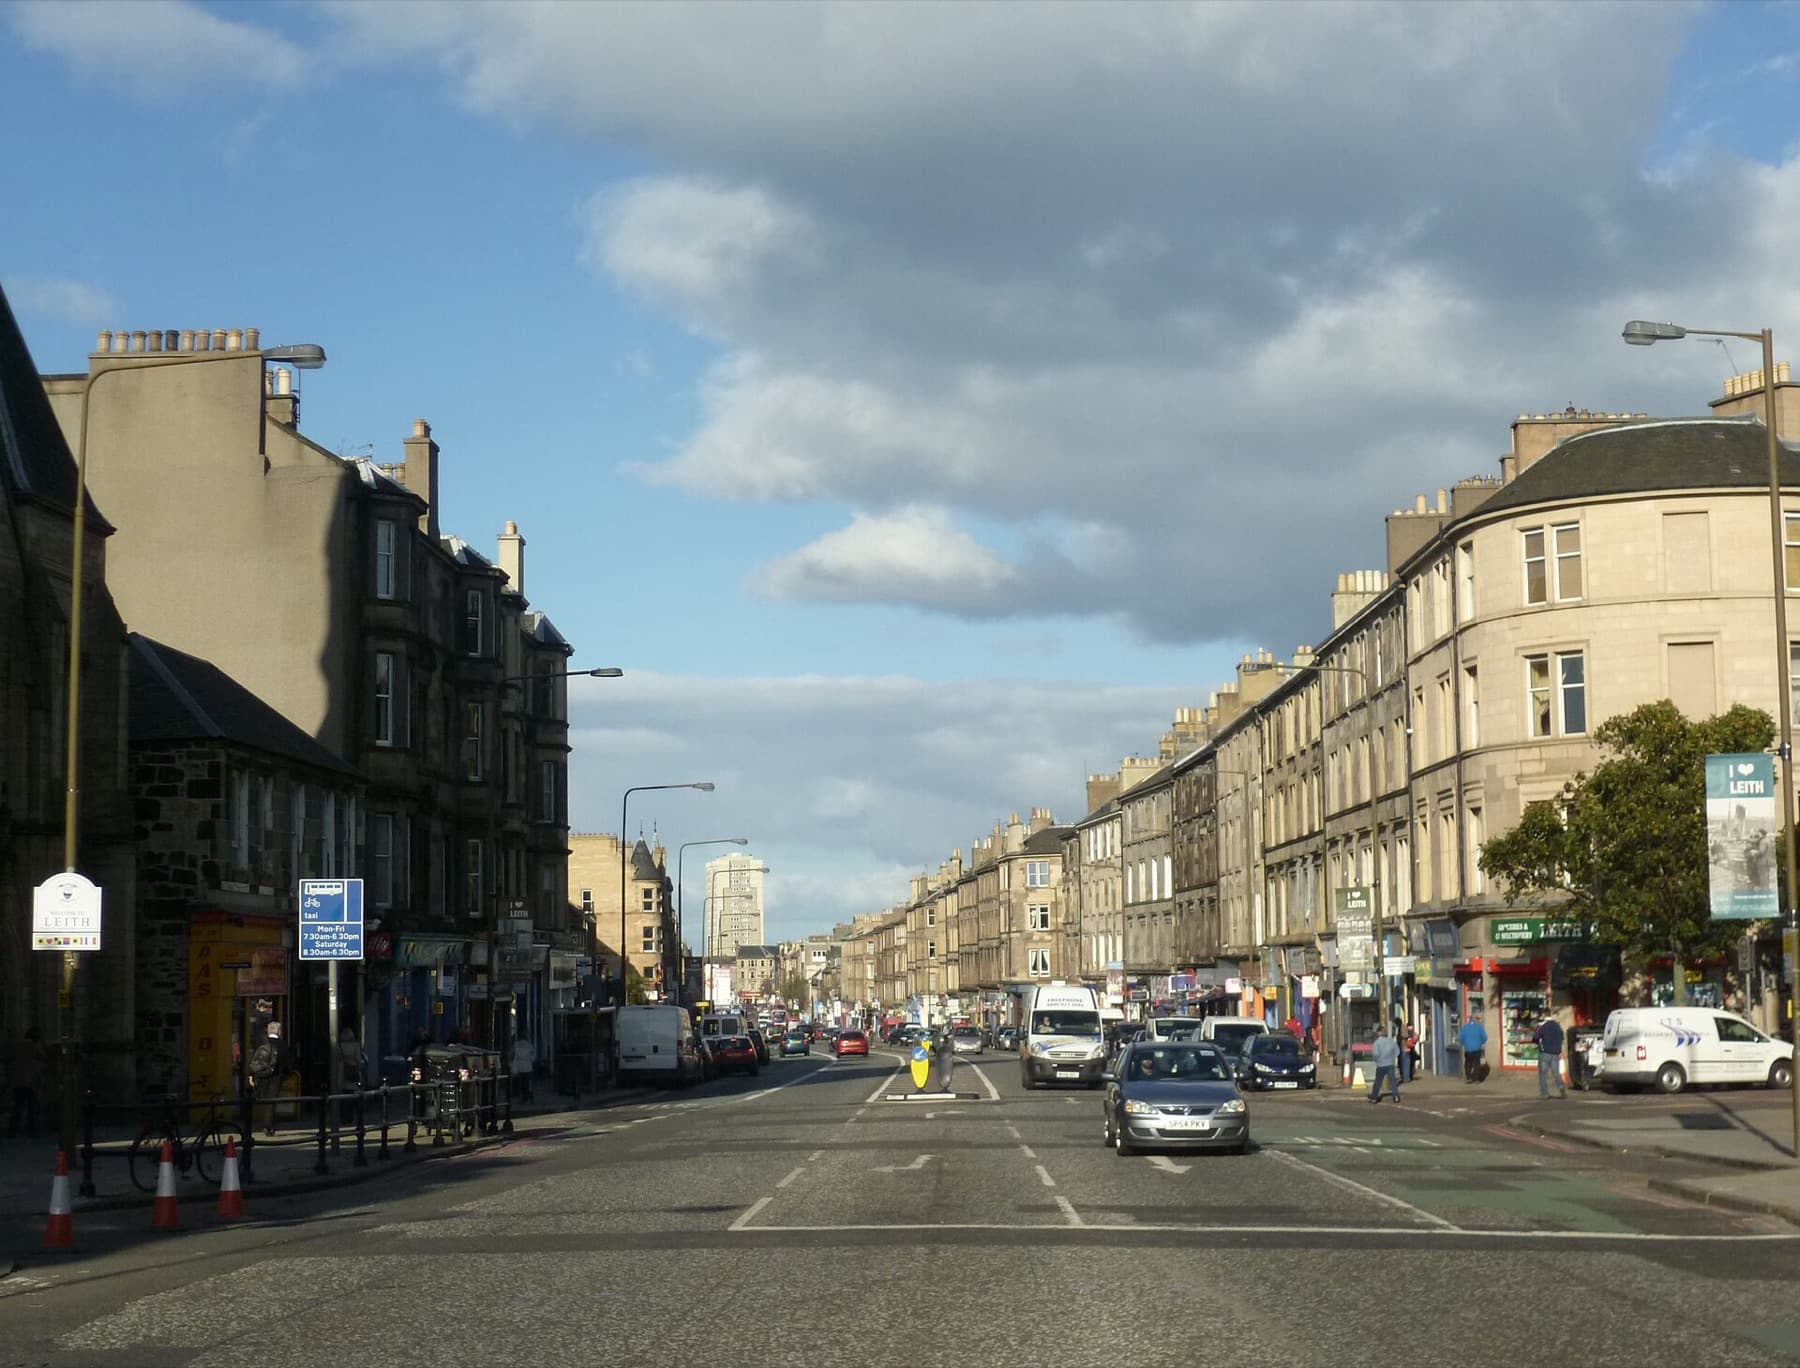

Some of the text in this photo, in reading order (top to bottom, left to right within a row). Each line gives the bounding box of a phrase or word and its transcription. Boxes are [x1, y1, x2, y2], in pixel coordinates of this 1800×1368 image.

[1728, 764, 1734, 778] I
[1729, 780, 1764, 794] LEITH
[1347, 900, 1367, 908] LEITH
[510, 910, 529, 918] LEITH
[44, 917, 90, 927] LEITH
[315, 940, 348, 948] Saturday
